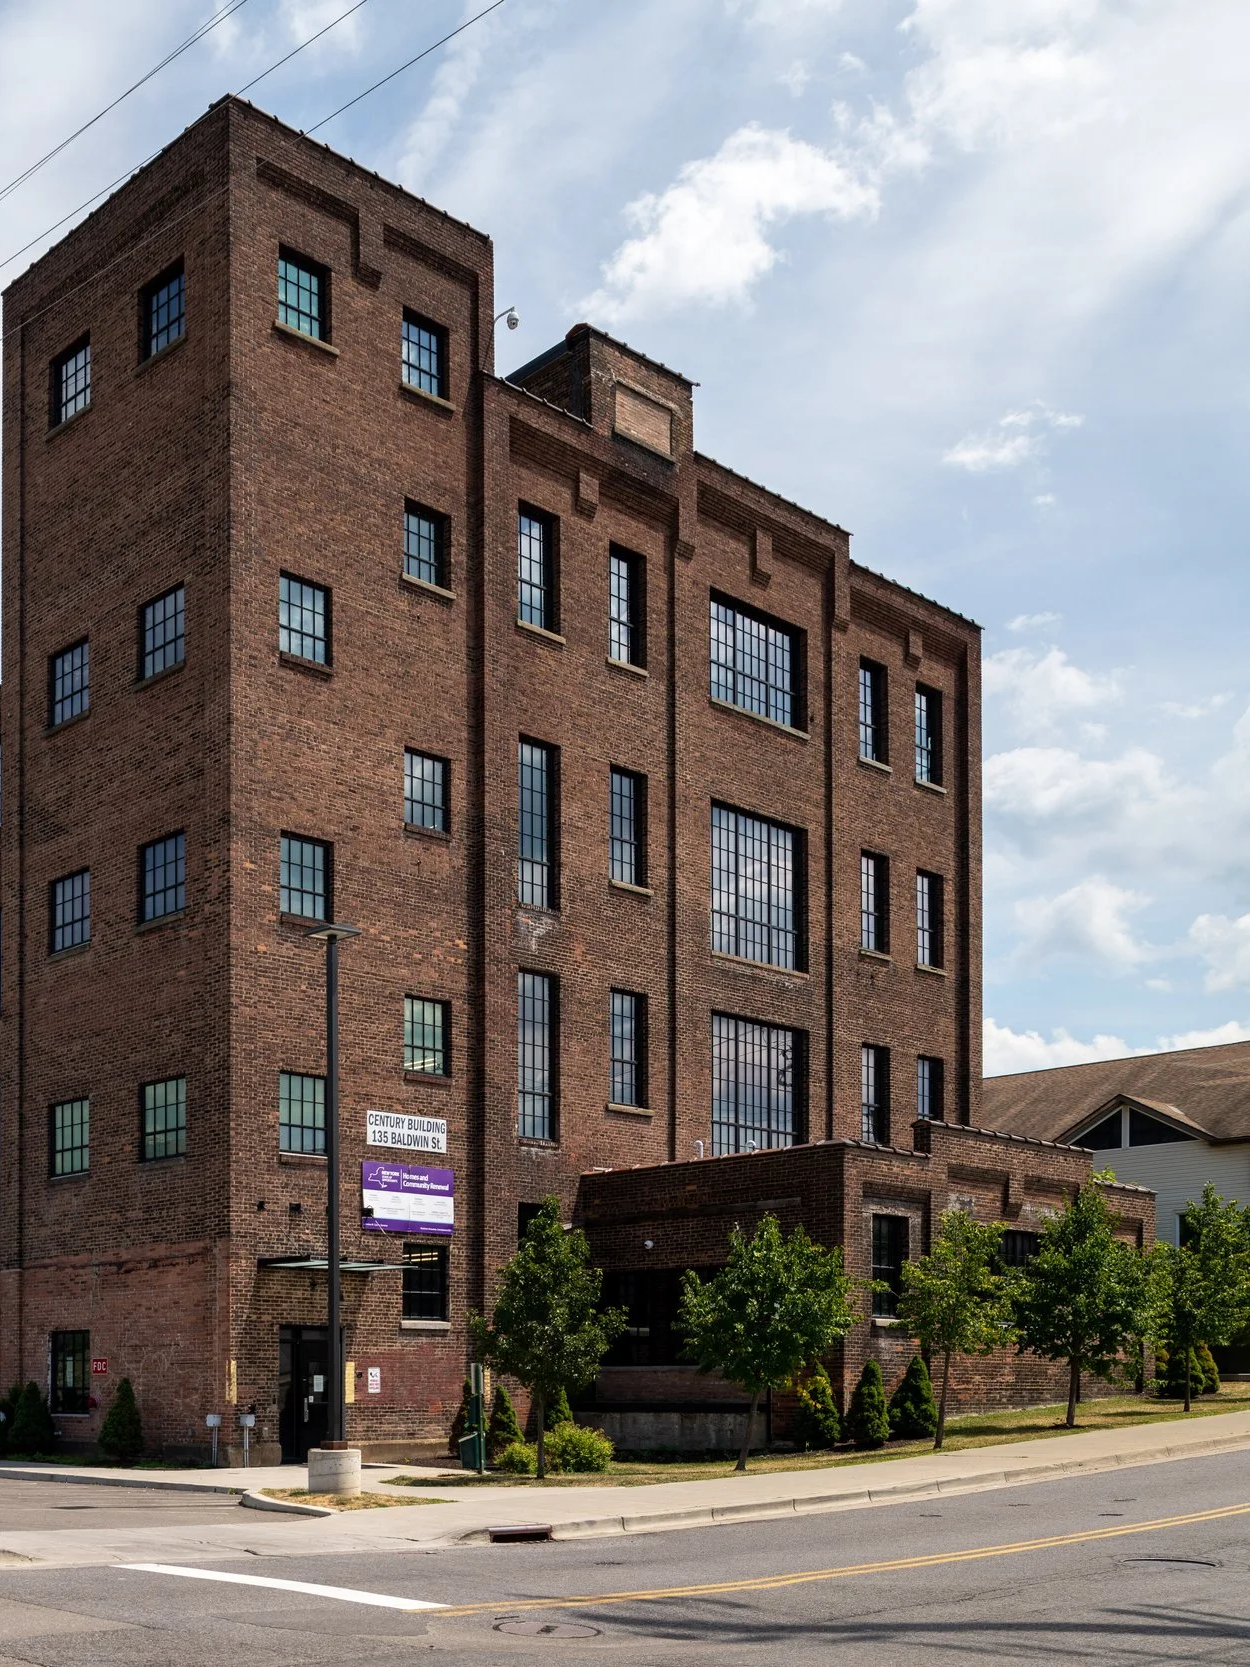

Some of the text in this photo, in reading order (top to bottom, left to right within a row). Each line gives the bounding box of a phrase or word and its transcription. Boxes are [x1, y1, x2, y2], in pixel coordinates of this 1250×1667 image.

[368, 1113, 446, 1134] CENTURY BUILDING
[372, 1129, 443, 1150] 135 BALDWIN St.
[402, 1172, 420, 1181] Homes
[402, 1180, 430, 1190] Community
[430, 1182, 449, 1191] Renewal
[93, 1362, 106, 1371] FDC
